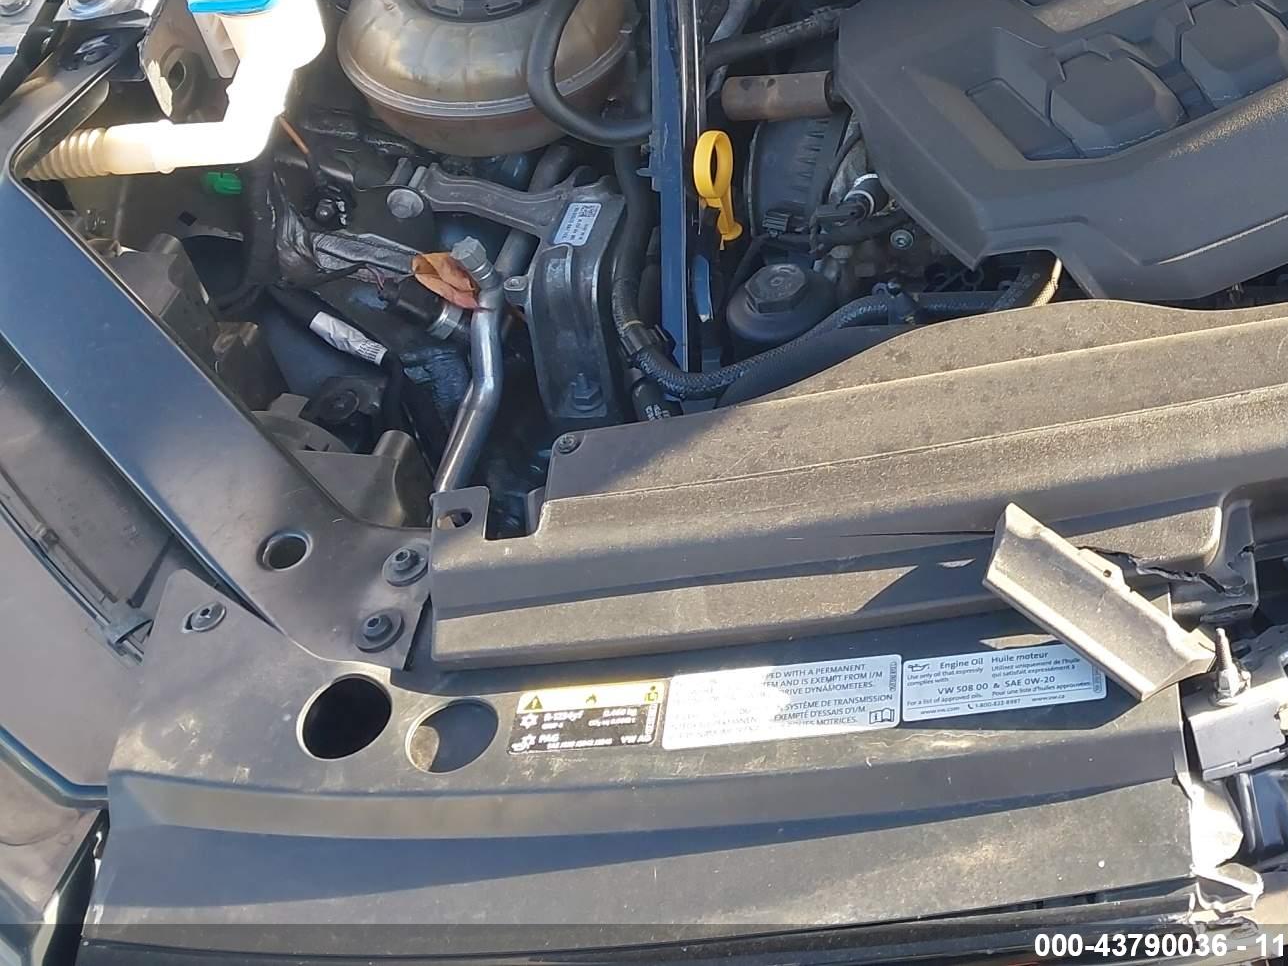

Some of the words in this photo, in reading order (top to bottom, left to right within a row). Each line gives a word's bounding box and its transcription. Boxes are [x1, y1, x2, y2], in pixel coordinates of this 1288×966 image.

[940, 659, 969, 670] Engine
[971, 657, 984, 666] Oil
[991, 654, 1015, 663] Huile
[1016, 652, 1048, 660] moteur
[783, 669, 806, 678] WITH
[815, 664, 867, 674] PERMANENT
[1014, 660, 1052, 669] uniquement
[780, 679, 800, 687] AND
[810, 675, 842, 684] EXEMPT
[844, 673, 867, 681] FROM
[868, 671, 883, 679] I/M
[1002, 669, 1027, 677] satisfait
[937, 687, 954, 695] VW
[956, 684, 974, 693] 508
[976, 682, 989, 690] 00
[1004, 680, 1022, 688] SAE
[1024, 676, 1056, 685] 0W-20
[820, 699, 832, 707] DE
[833, 694, 893, 706] TRANSMISSION
[941, 694, 970, 702] approved
[774, 710, 808, 722] EXEMPTÉ
[810, 707, 843, 718] D'ESSAIS
